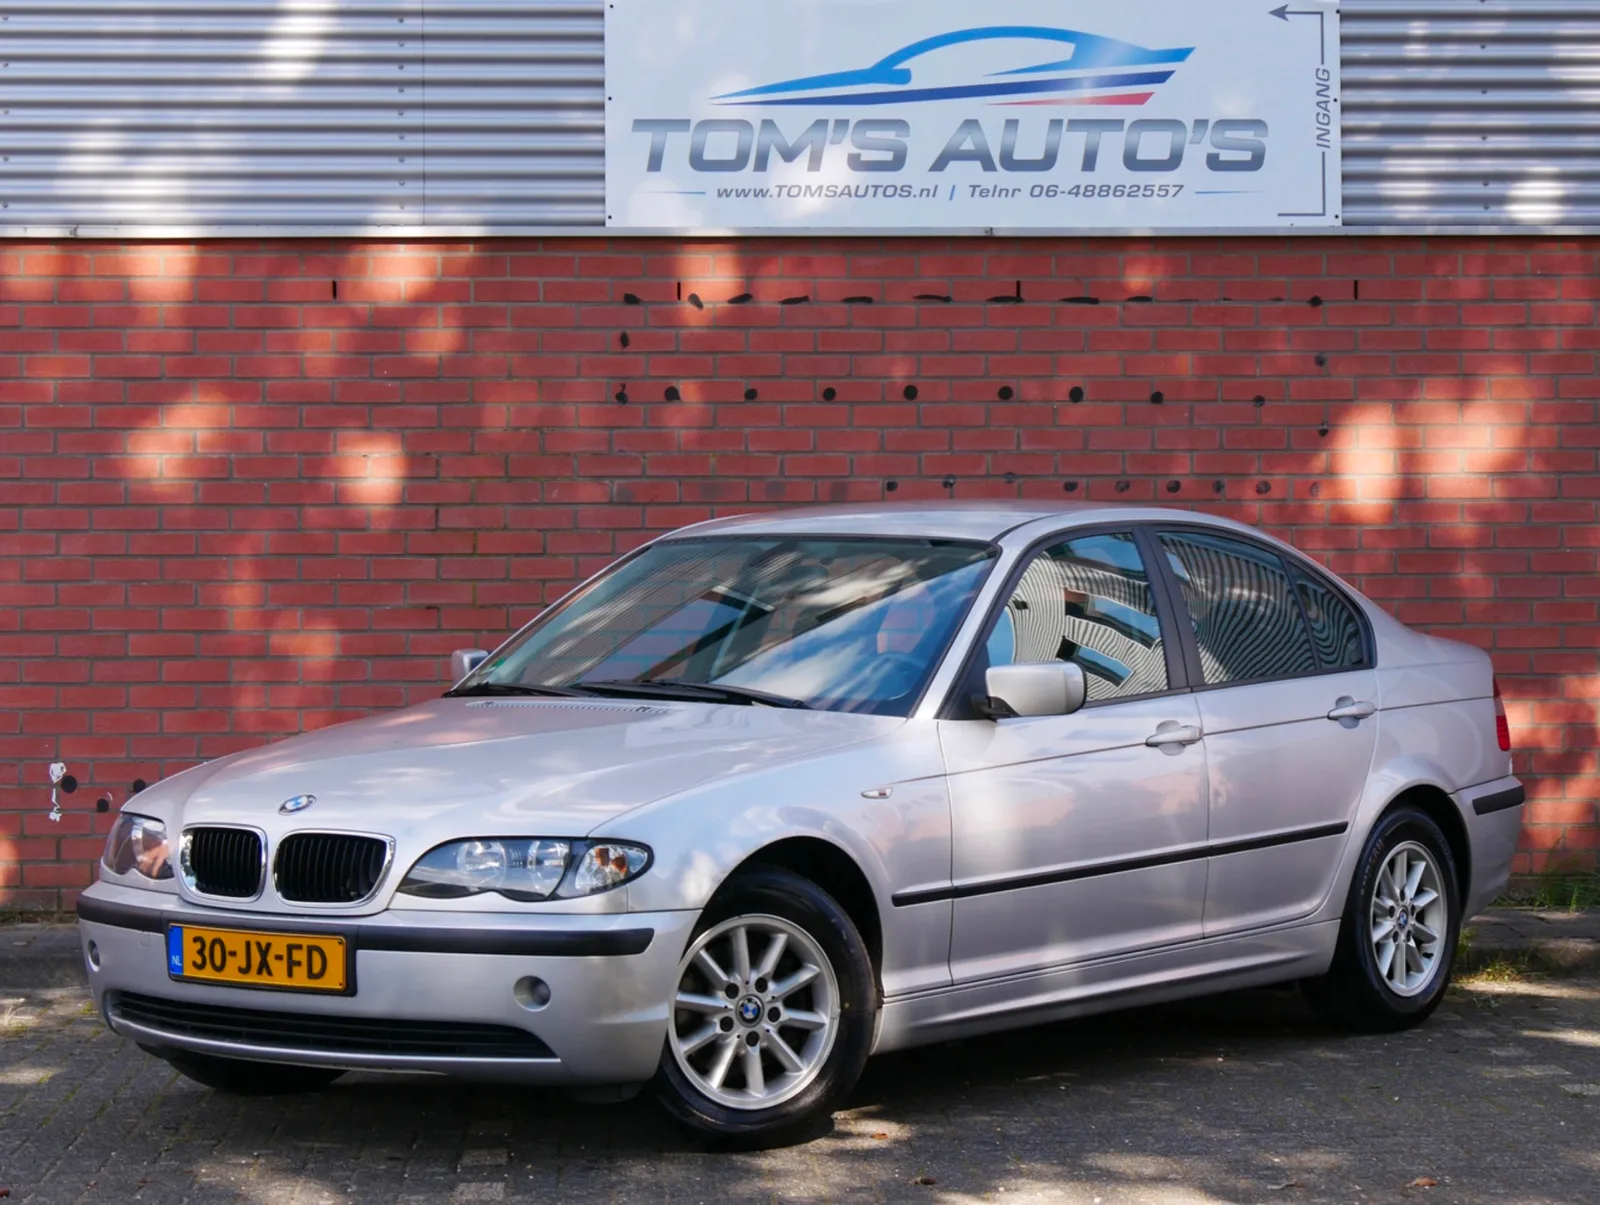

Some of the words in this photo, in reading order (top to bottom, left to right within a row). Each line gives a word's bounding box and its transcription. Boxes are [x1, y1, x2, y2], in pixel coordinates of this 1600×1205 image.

[1315, 67, 1331, 149] INGANG
[631, 118, 911, 173] TOM'S
[927, 118, 1269, 172] AUTO'S
[716, 184, 938, 199] www.TOMSAUTOS.nl
[968, 184, 1021, 198] Telnr
[1029, 184, 1184, 198] 06-48862557
[171, 954, 183, 967] NL
[191, 935, 328, 980] 30-JX-FD
